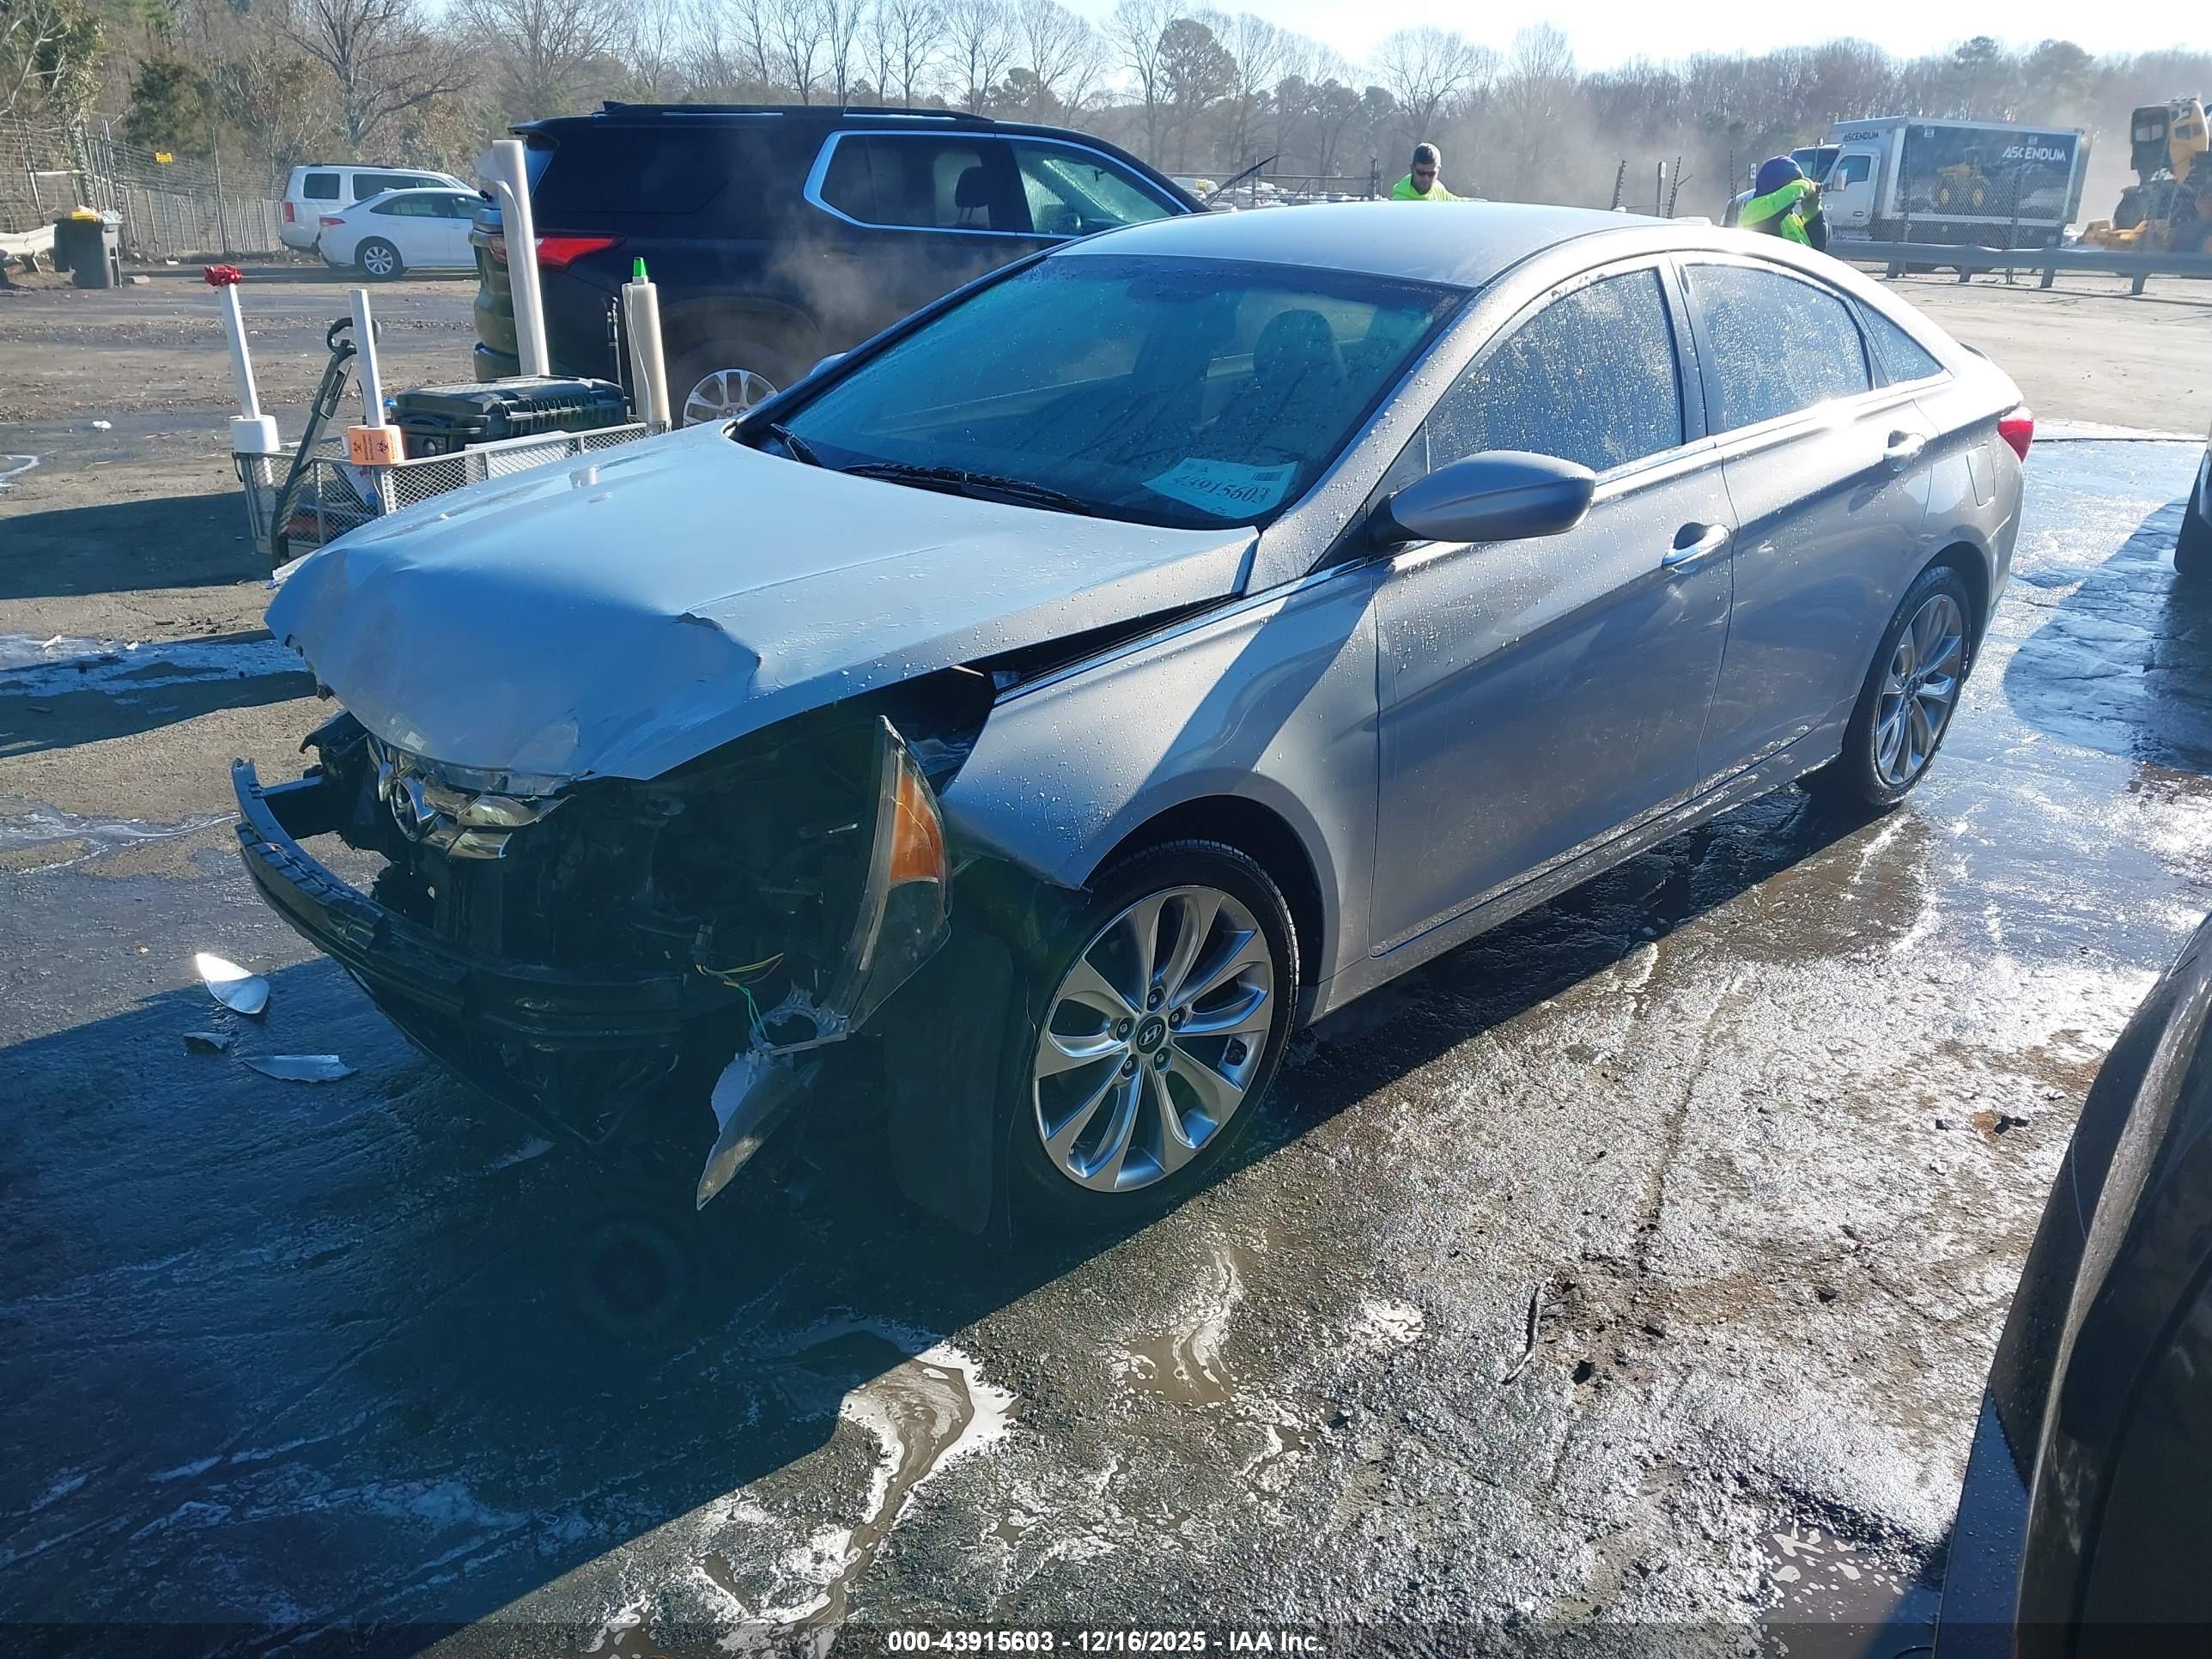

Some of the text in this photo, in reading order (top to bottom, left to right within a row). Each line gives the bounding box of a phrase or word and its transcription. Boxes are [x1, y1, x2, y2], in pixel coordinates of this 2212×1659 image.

[1842, 131, 1880, 142] ASCENDUM
[2002, 145, 2066, 161] ASCENDUM
[1173, 475, 1272, 503] 43915603
